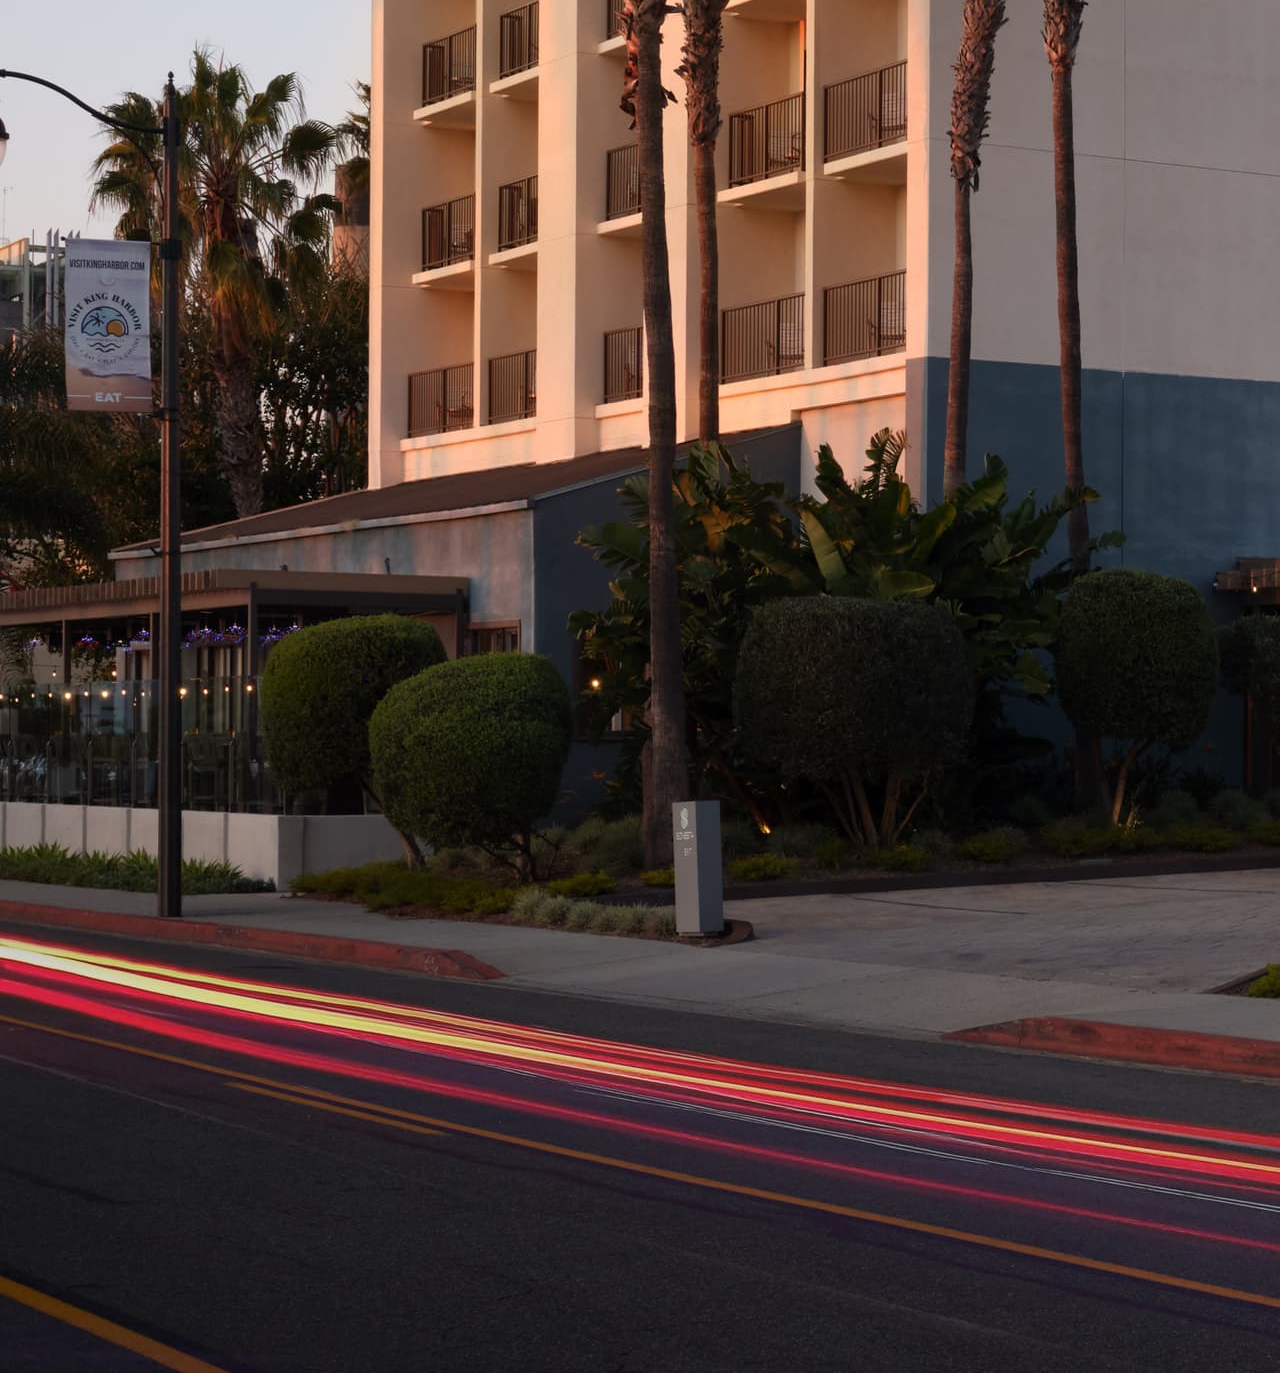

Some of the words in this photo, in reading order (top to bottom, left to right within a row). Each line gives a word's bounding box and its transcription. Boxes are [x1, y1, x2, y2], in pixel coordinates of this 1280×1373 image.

[69, 259, 145, 270] VISITKINGHARBOR.COM
[68, 303, 83, 328] VISIT
[84, 292, 109, 305] KING
[112, 294, 142, 331] HARBOR
[95, 392, 122, 403] EAT
